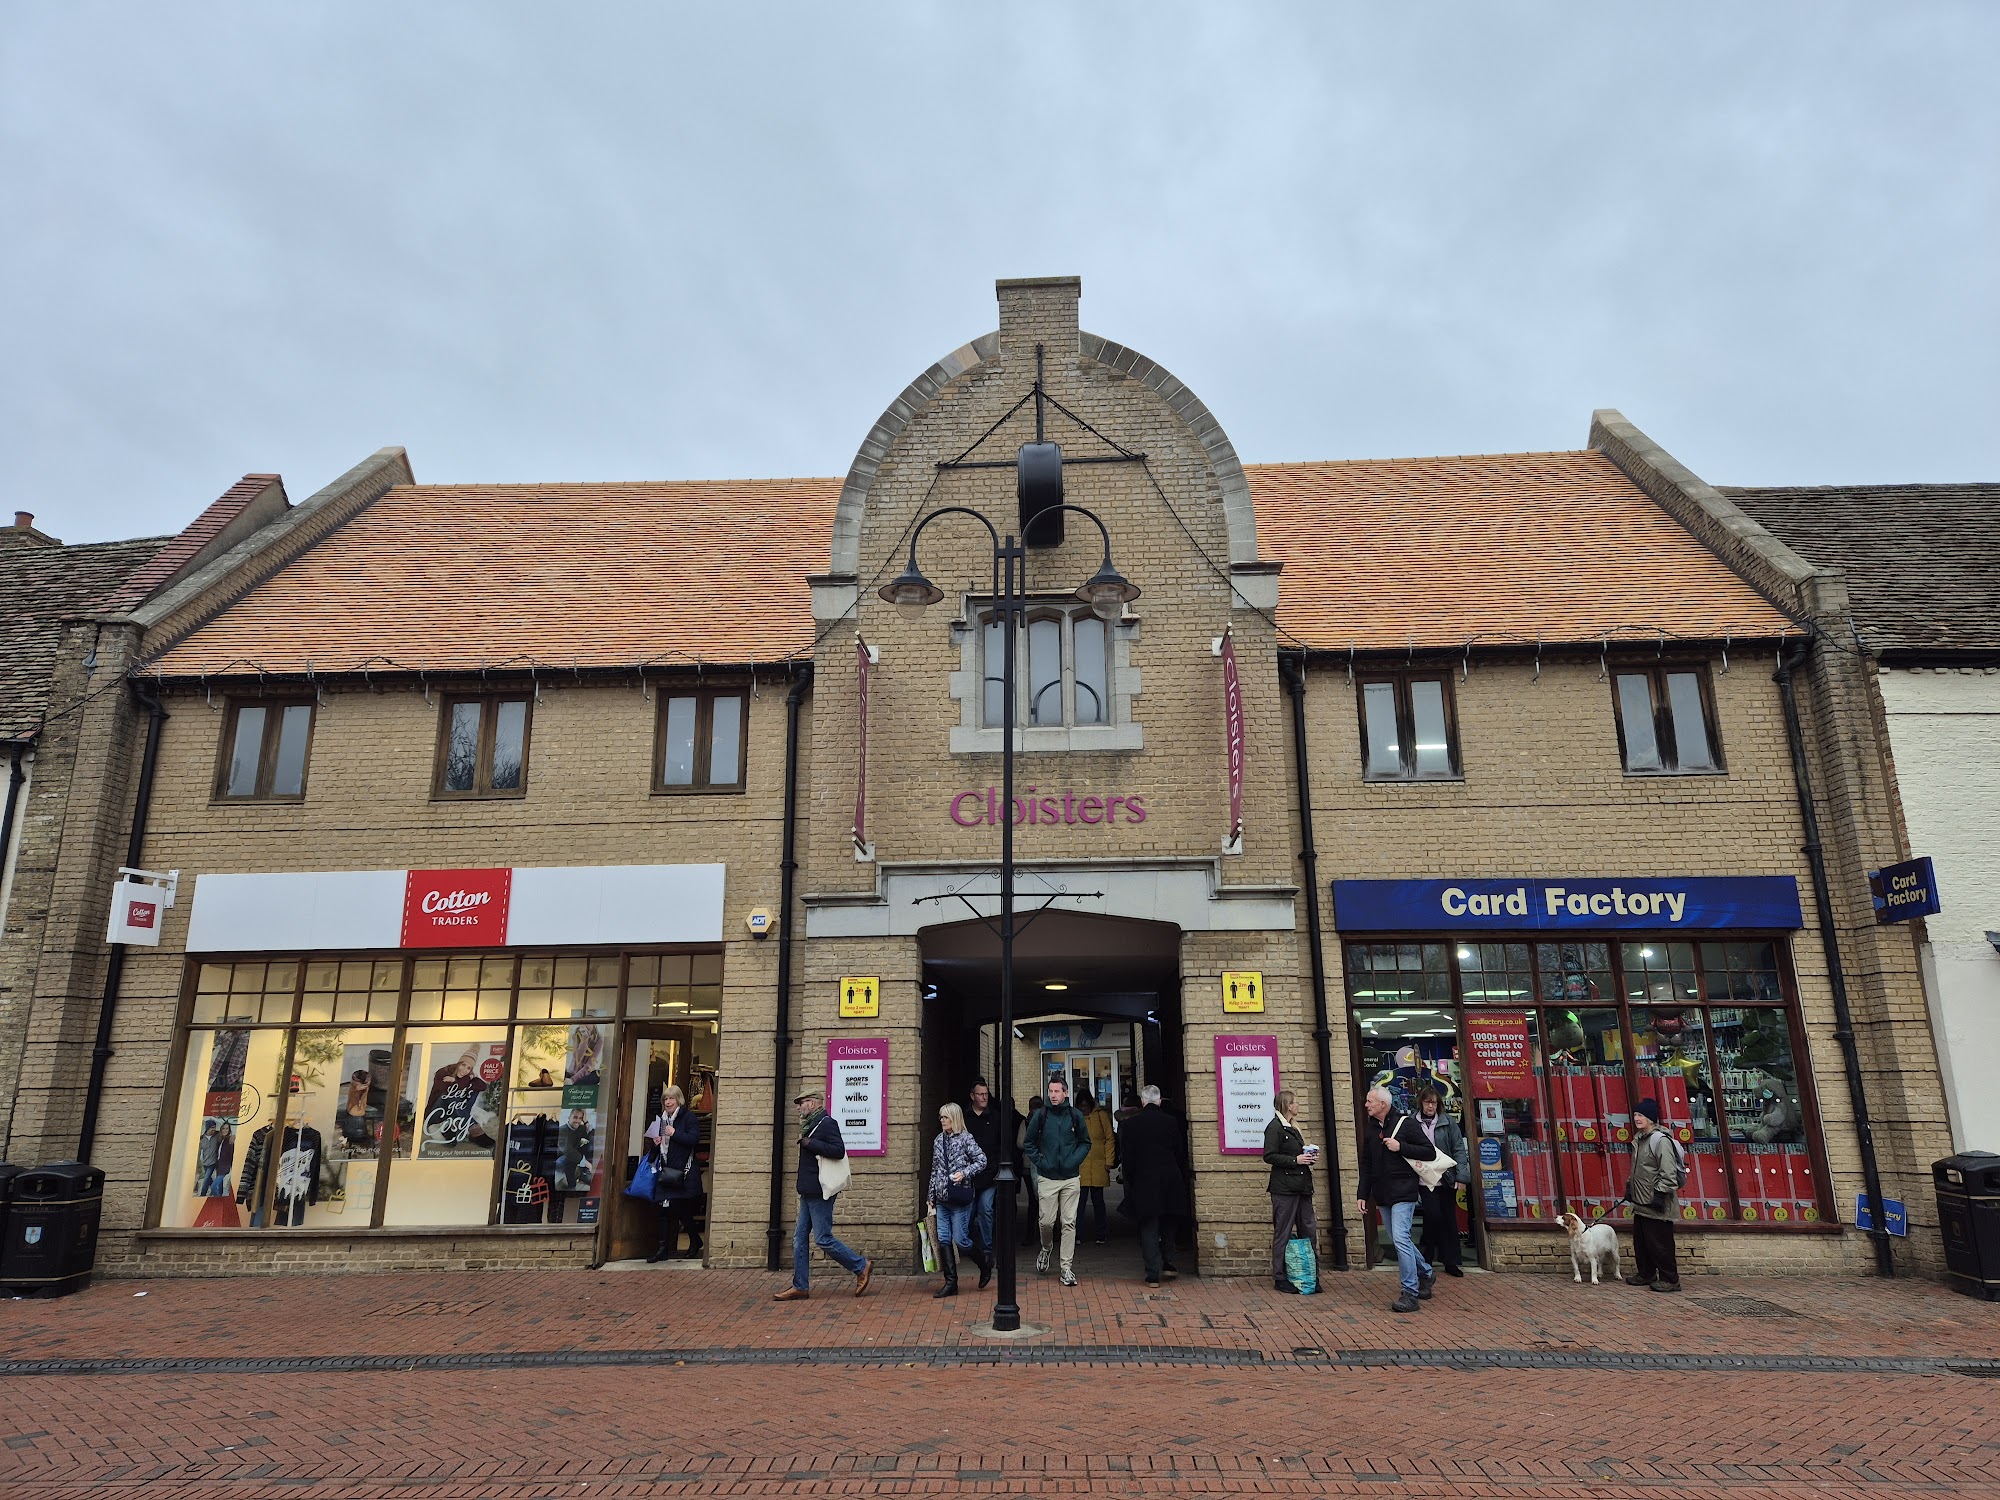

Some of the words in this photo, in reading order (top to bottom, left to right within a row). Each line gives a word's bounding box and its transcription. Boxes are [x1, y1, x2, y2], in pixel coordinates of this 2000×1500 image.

[1227, 657, 1241, 798] Cloisters
[950, 785, 1147, 827] Cloisters
[1891, 871, 1918, 891] Card
[421, 889, 491, 914] Cotton
[1886, 887, 1927, 907] Factory
[1441, 887, 1529, 916] Card
[1544, 887, 1687, 922] Factory
[132, 907, 151, 917] Cotton
[432, 915, 479, 926] TRADERS
[752, 917, 765, 925] ADT
[1468, 1018, 1523, 1026] cardfactory.co.uk
[838, 1045, 878, 1055] Cloisters
[1225, 1042, 1267, 1051] Cloisters
[1477, 1050, 1522, 1058] celebrate
[1233, 1062, 1243, 1074] Sue
[1244, 1063, 1261, 1075] Ryder
[1486, 1058, 1515, 1066] online
[441, 1083, 474, 1100] Let's
[845, 1092, 869, 1102] wilko
[445, 1099, 468, 1116] get
[422, 1107, 475, 1147] Cosy
